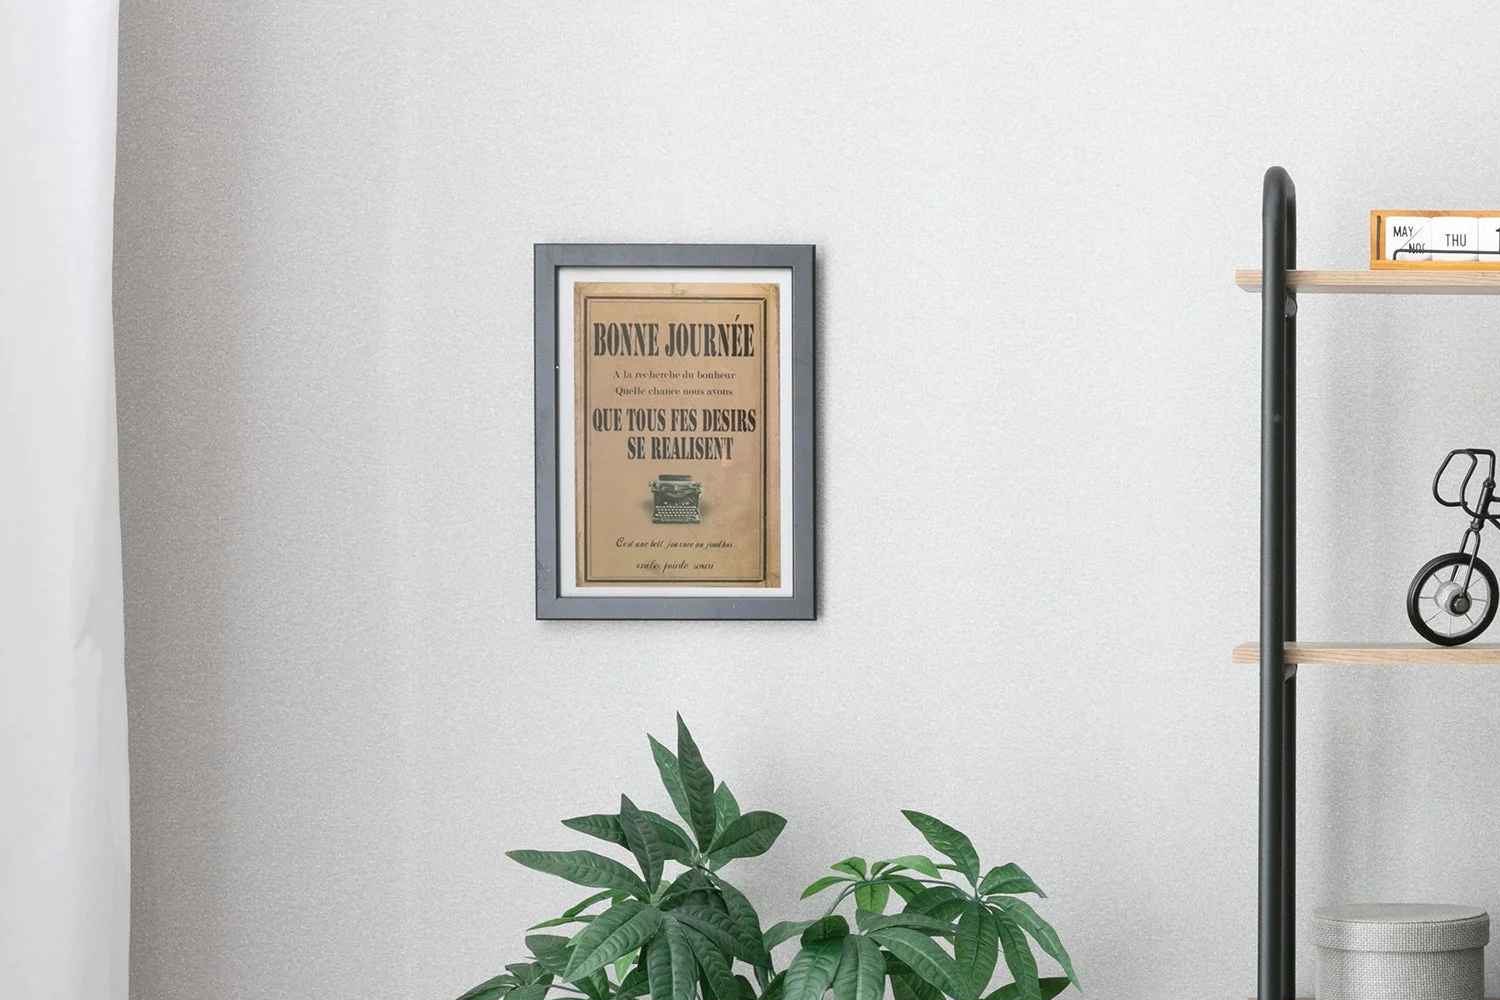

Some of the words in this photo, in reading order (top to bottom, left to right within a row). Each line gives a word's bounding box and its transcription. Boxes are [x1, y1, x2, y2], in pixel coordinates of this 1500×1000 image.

[1393, 226, 1413, 237] MAY
[1445, 233, 1467, 247] THU
[593, 322, 659, 357] BONNE
[665, 314, 755, 358] JOURNÉE
[613, 371, 620, 379] A
[623, 370, 632, 379] la
[635, 370, 681, 379] recherche
[682, 370, 694, 379] du
[697, 370, 736, 380] bonheur
[615, 386, 646, 397] Quelle
[648, 386, 681, 396] chance
[683, 387, 705, 396] nous
[706, 387, 734, 396] avons
[592, 408, 623, 432] QUE
[626, 408, 666, 432] TOUS
[671, 408, 697, 432] FES
[702, 408, 757, 433] DESIRS
[627, 436, 646, 460] SE
[651, 436, 734, 461] REALISENT
